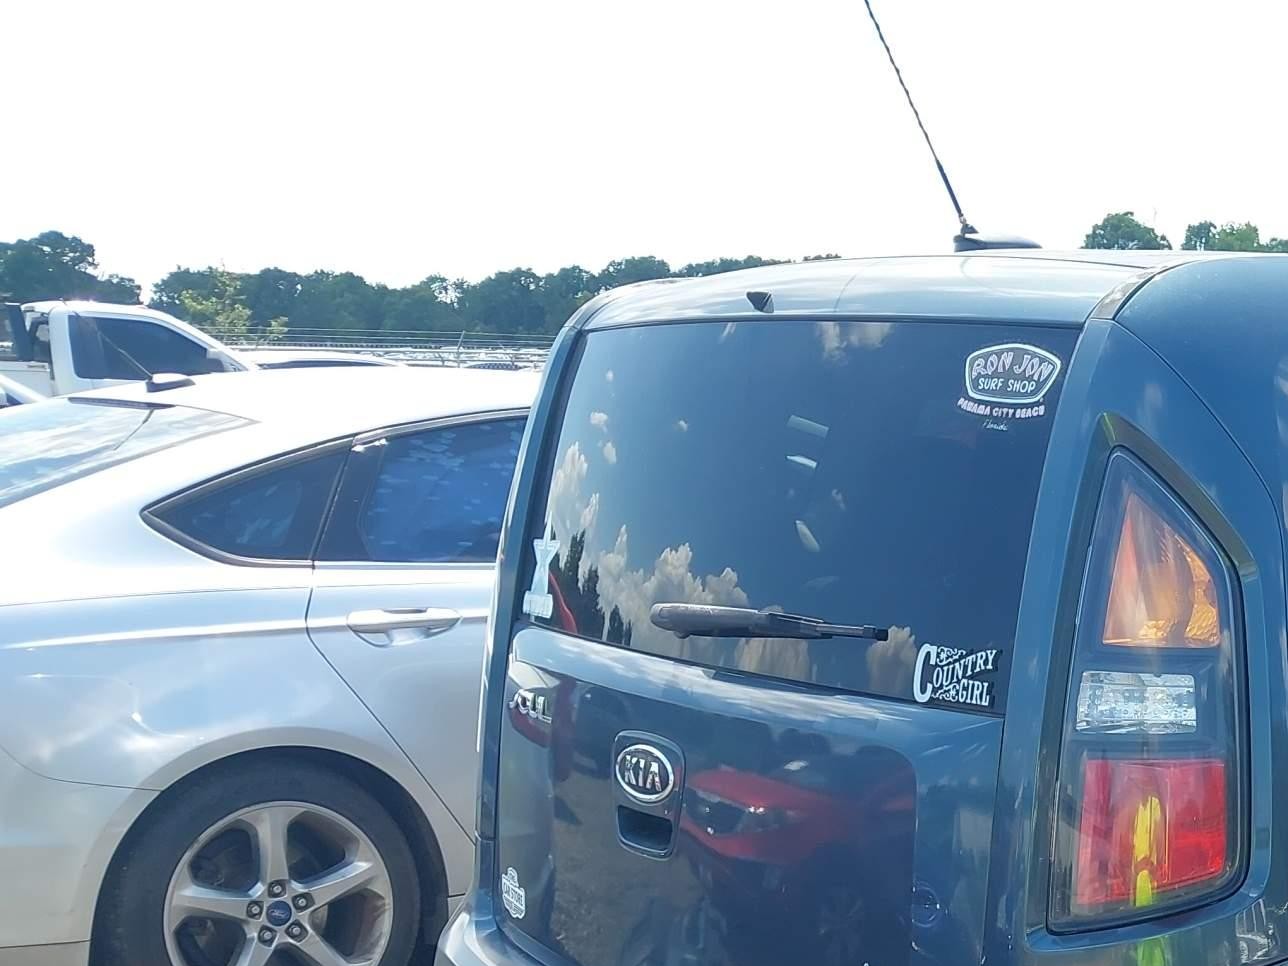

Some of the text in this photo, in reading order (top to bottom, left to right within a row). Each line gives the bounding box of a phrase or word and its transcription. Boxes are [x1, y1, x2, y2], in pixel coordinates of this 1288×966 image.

[971, 351, 1054, 382] RON JON
[978, 377, 1036, 394] SURF SHOP
[957, 397, 1046, 419] PANAMA CITY BEACH
[959, 678, 990, 706] GIRL
[624, 754, 662, 792] KIA
